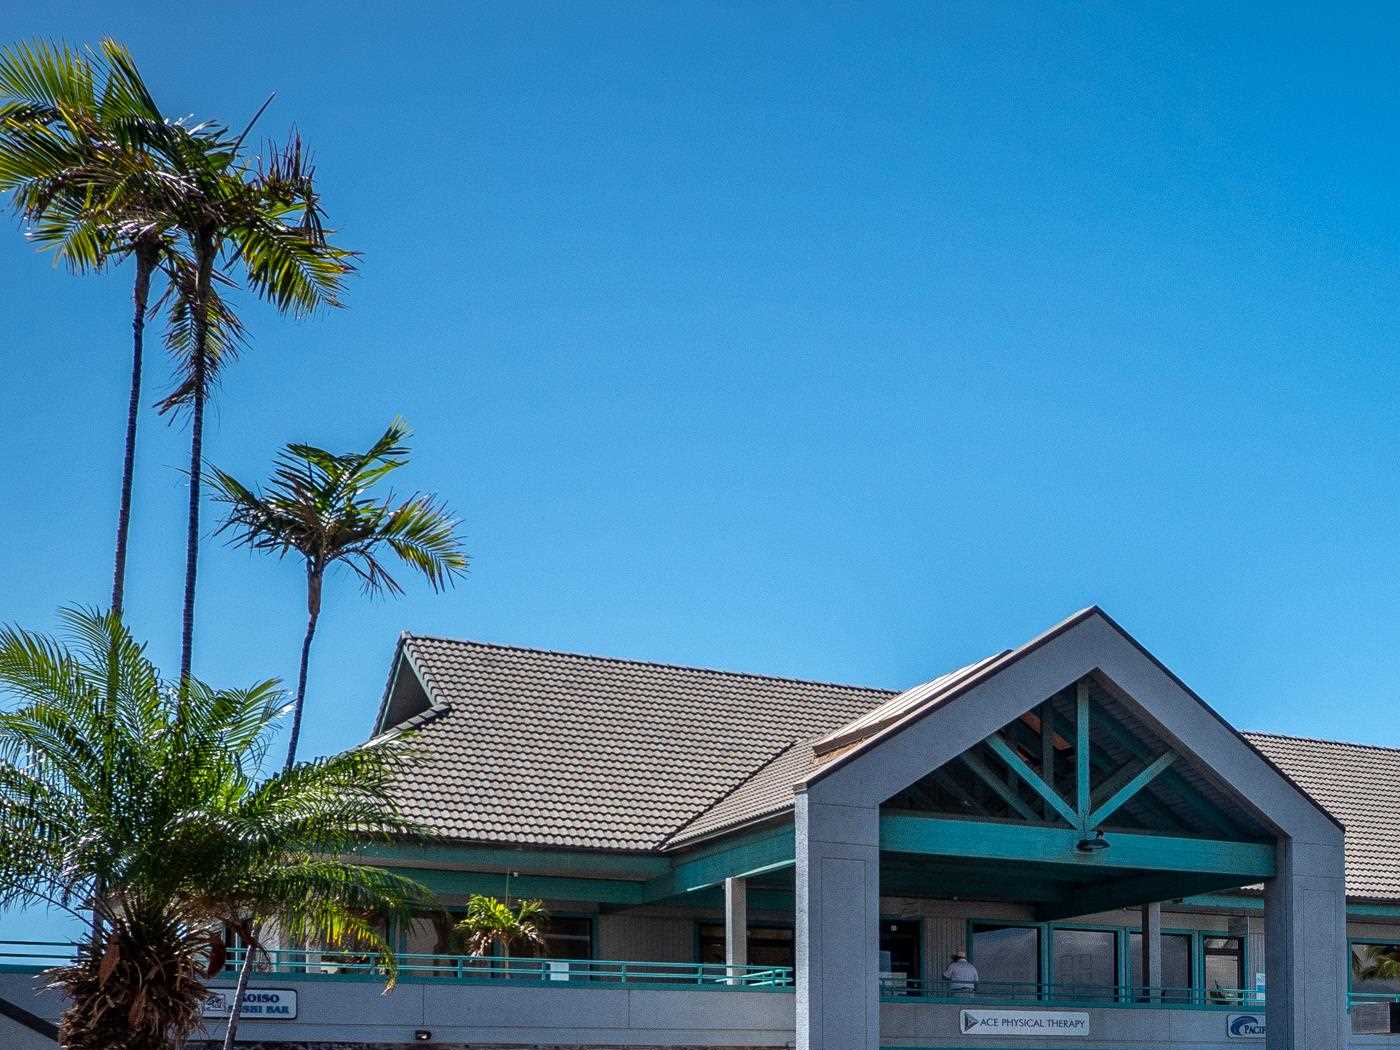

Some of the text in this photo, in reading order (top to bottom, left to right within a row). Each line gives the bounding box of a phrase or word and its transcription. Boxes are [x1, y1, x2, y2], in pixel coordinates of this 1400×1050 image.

[266, 1005, 289, 1014] BAR
[980, 1018, 1085, 1029] ACE PHYSICAL THERAPY
